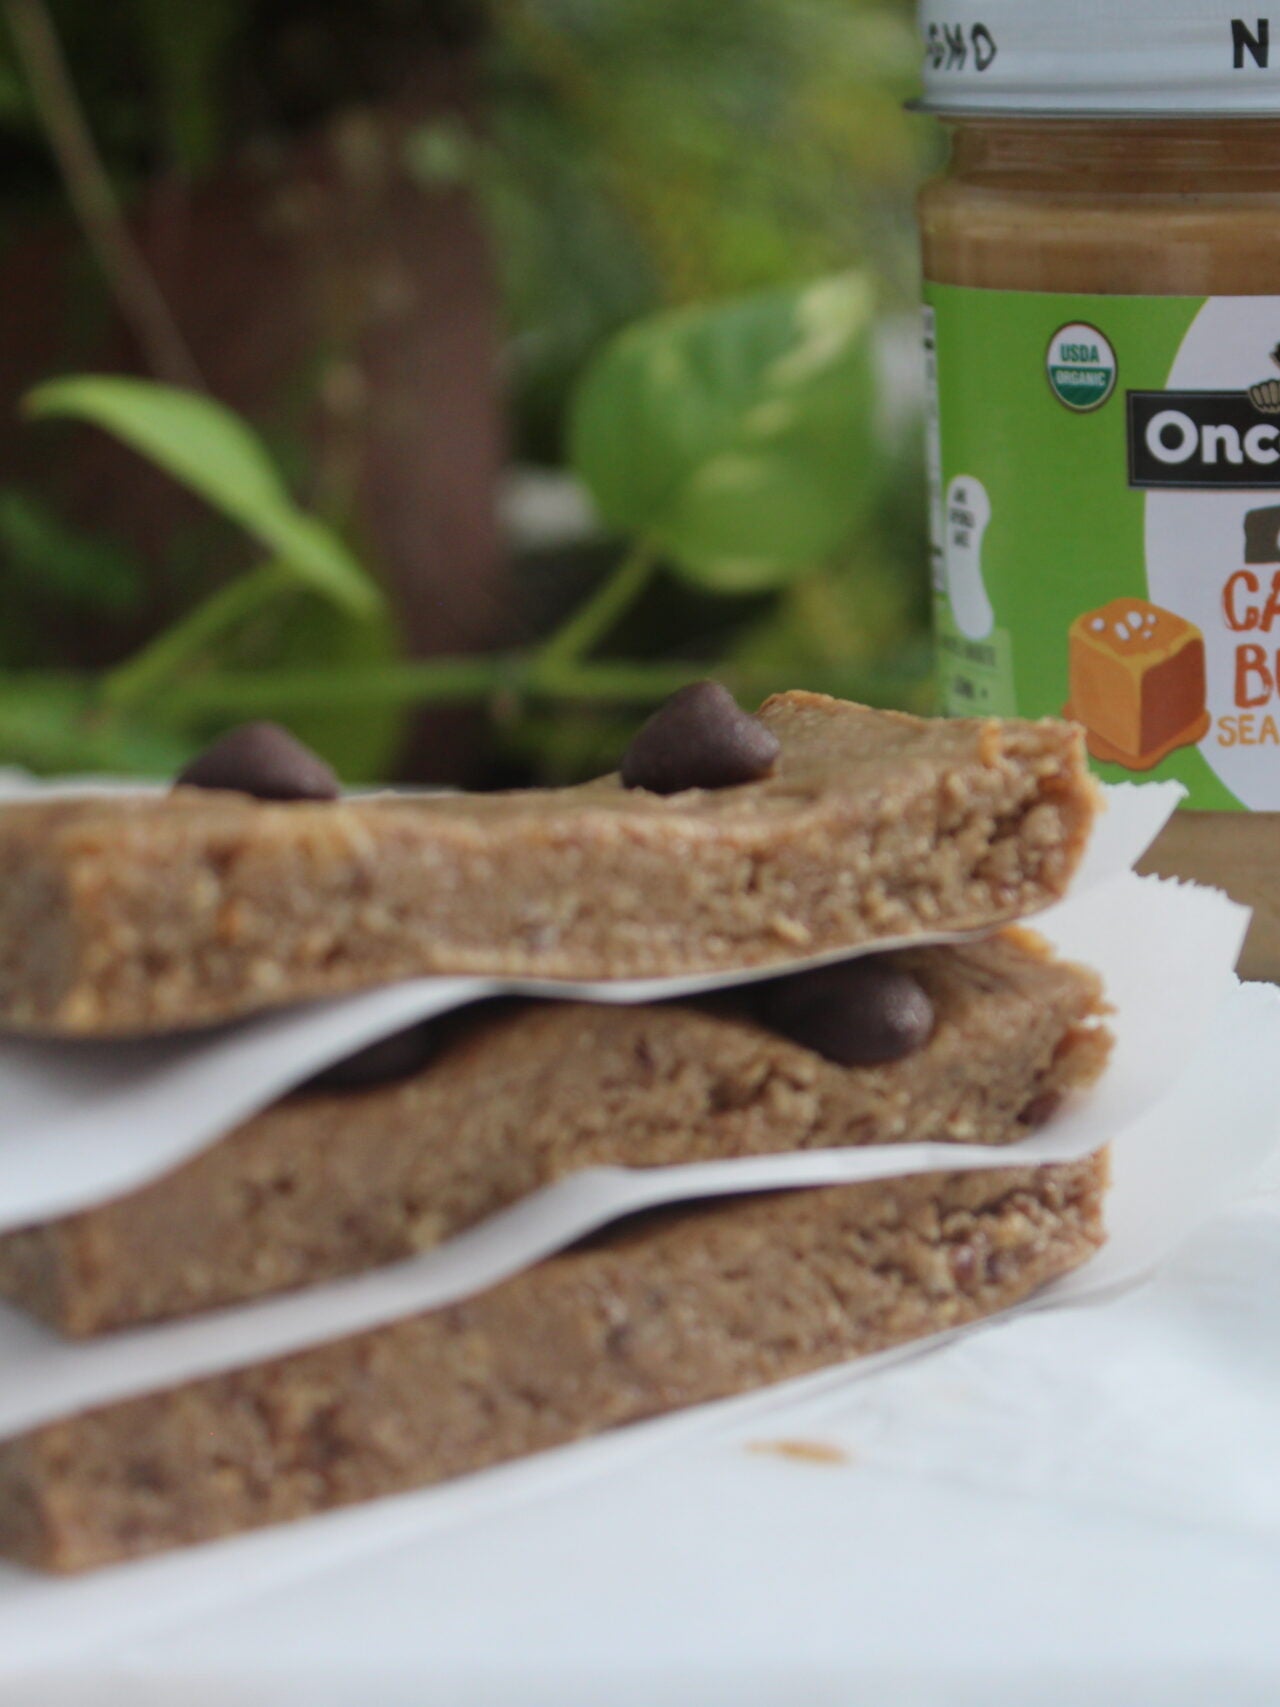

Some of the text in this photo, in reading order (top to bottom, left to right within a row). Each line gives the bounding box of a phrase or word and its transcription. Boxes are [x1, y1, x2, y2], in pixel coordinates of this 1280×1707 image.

[1060, 343, 1100, 363] USDA
[1055, 369, 1106, 387] ORGANIC
[1216, 713, 1280, 748] SEA
